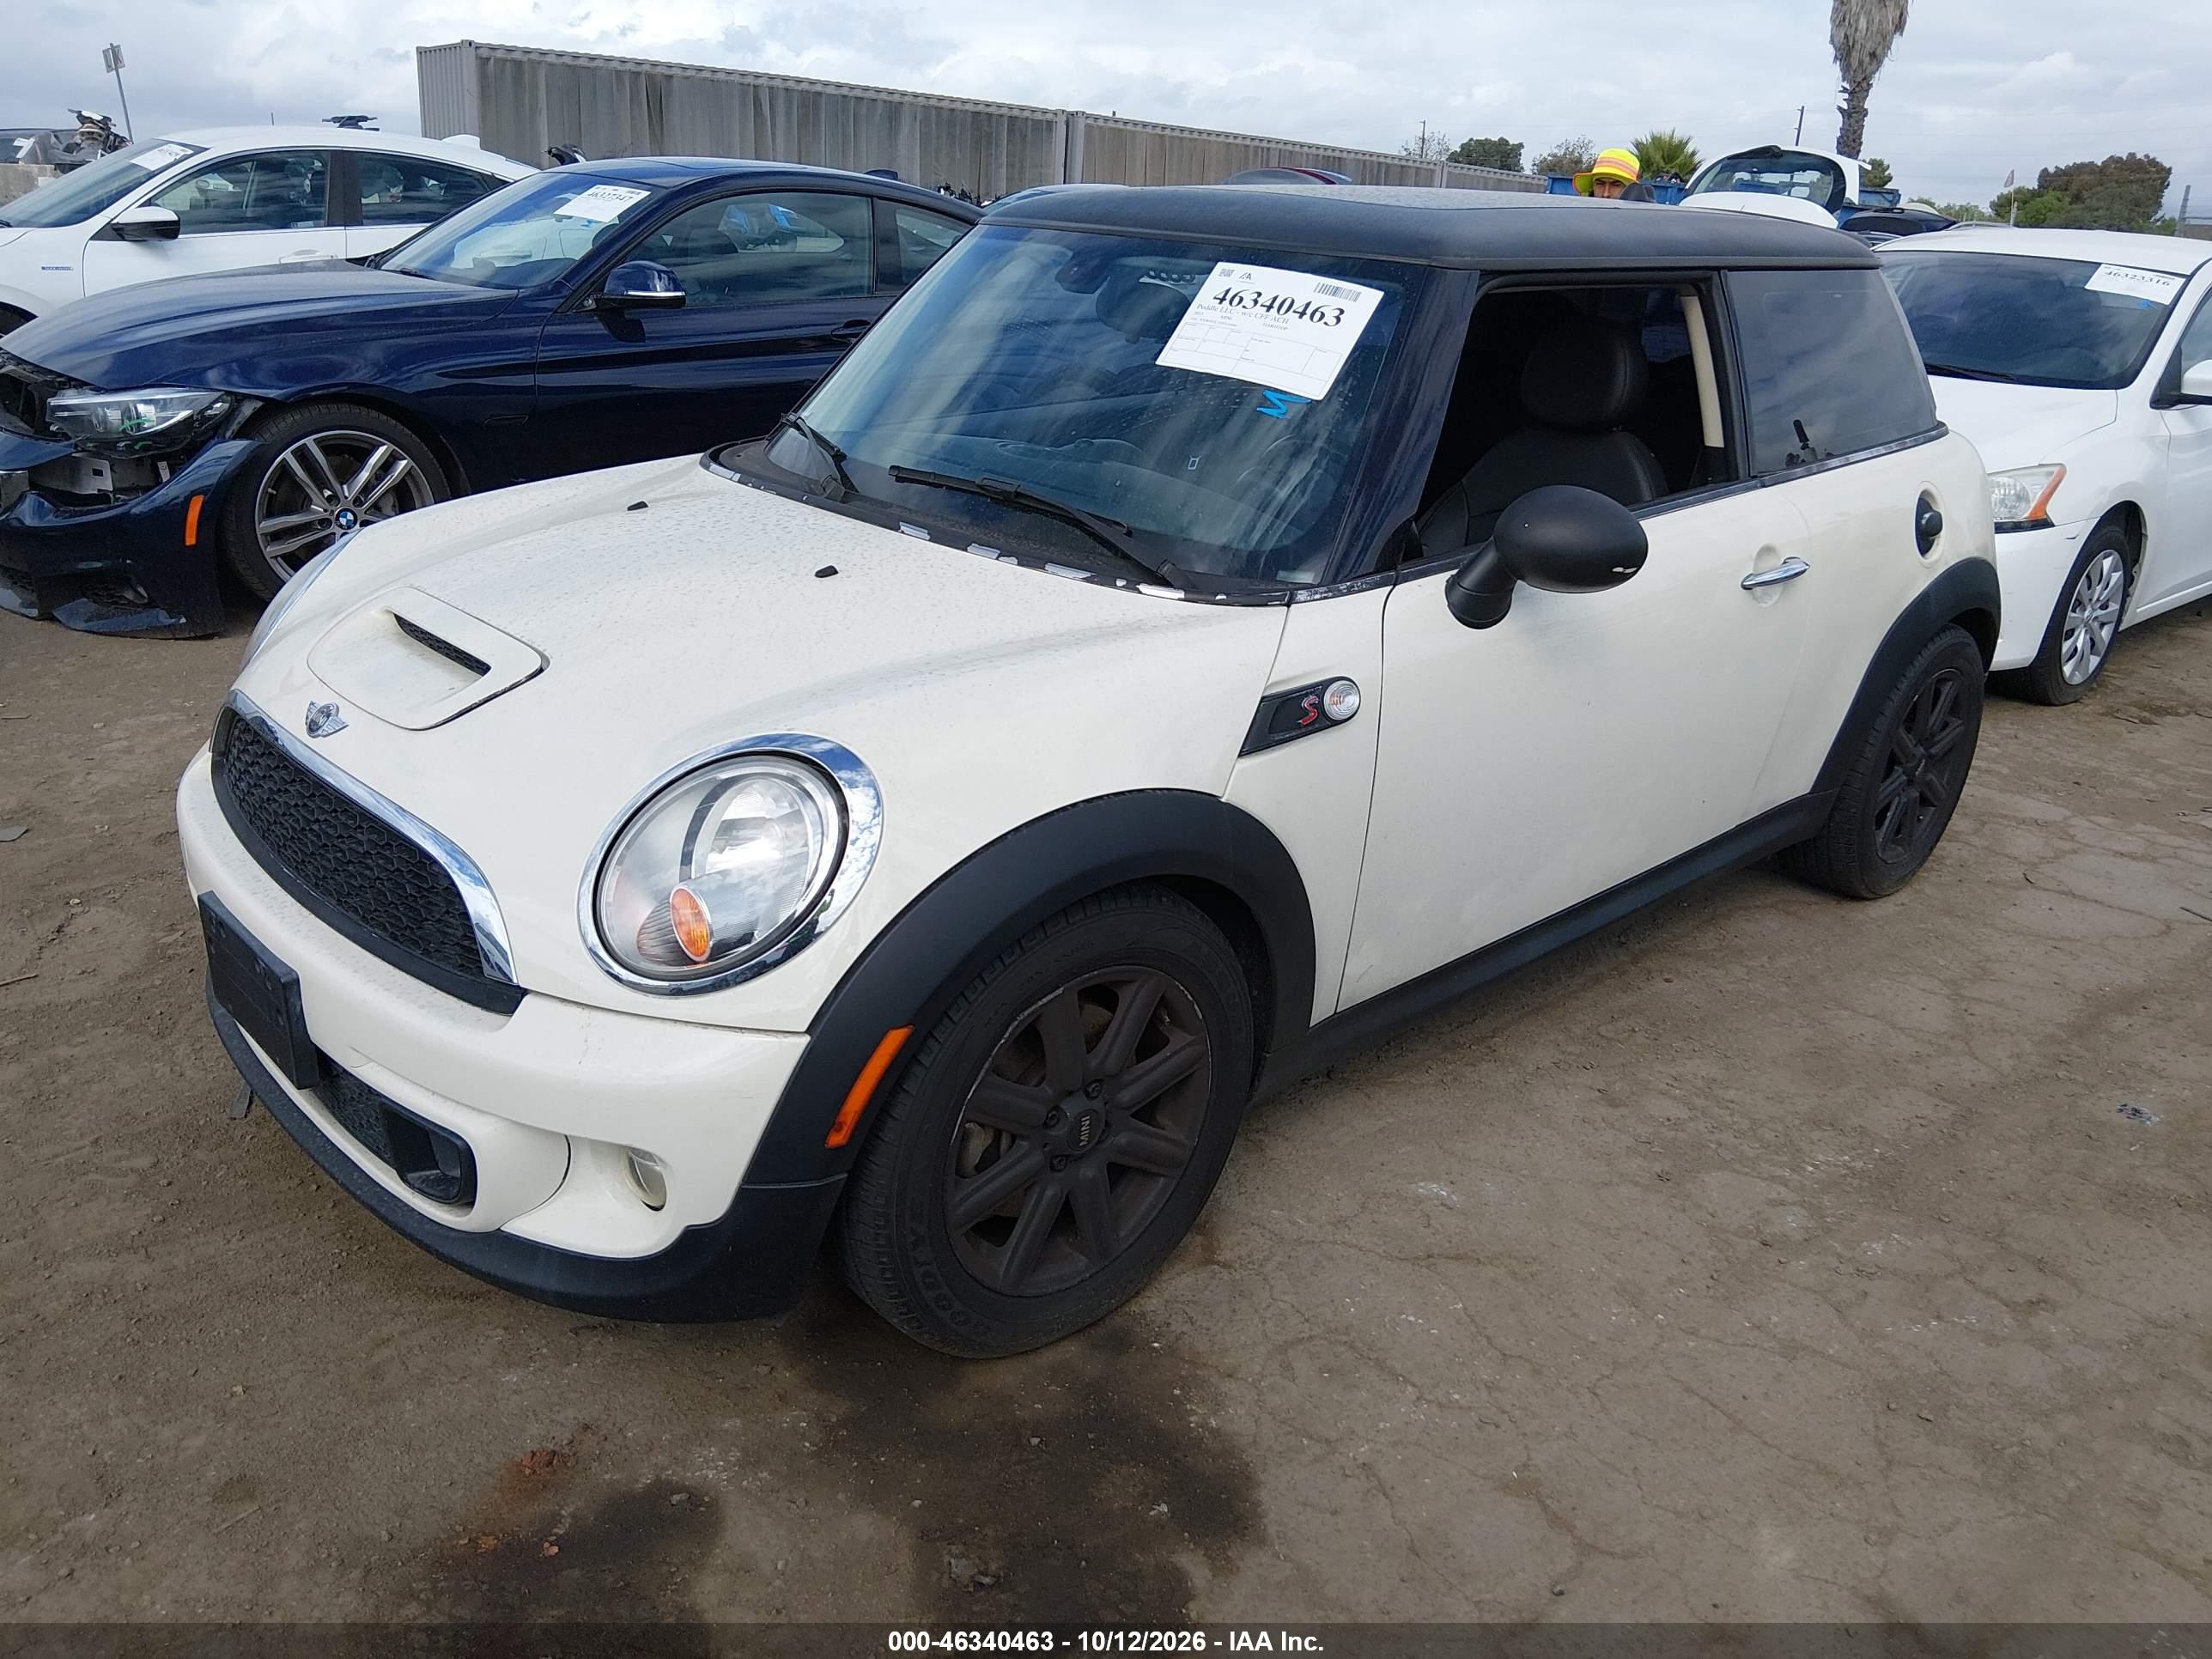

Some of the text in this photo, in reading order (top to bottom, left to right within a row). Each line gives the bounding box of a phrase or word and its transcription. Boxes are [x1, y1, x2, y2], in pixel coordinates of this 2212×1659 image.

[2105, 270, 2171, 286] 46323316
[1212, 287, 1346, 327] 46340463
[1297, 695, 1320, 726] S
[1079, 1115, 1091, 1146] MINI
